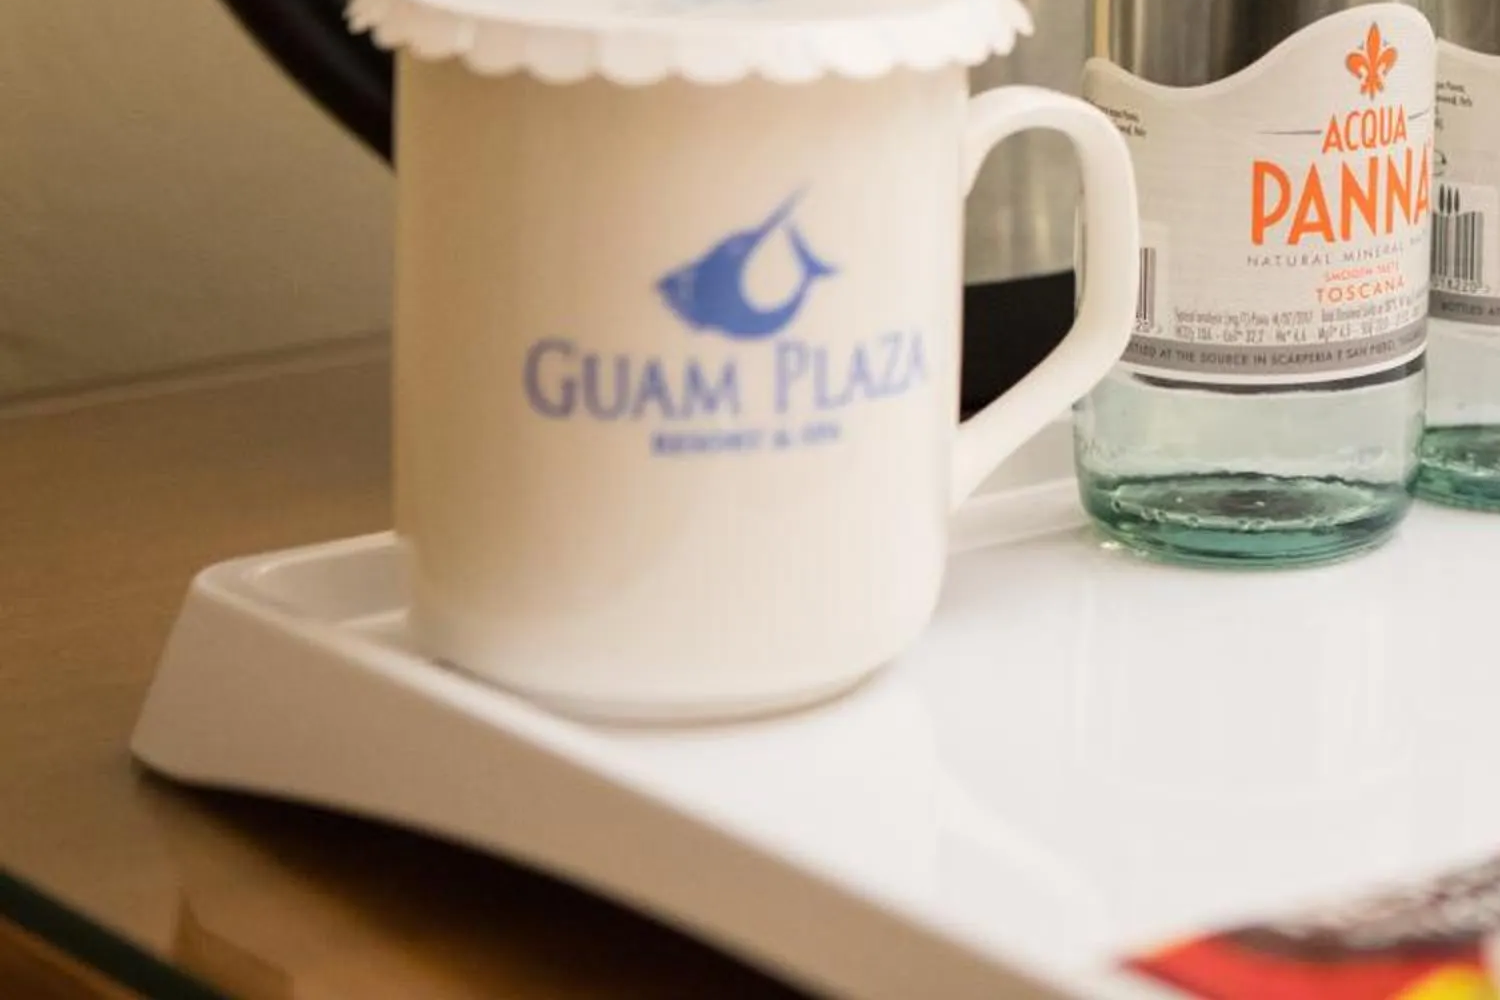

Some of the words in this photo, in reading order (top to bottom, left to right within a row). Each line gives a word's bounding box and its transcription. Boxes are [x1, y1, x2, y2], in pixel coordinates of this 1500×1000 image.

[1322, 104, 1407, 154] ACQUA
[1252, 143, 1430, 245] PANNA
[1247, 252, 1331, 267] NATURAL
[1343, 241, 1403, 261] MINERAL
[1315, 275, 1405, 303] TOSCANA
[523, 336, 740, 421] GUAM
[773, 330, 929, 415] PLAZA
[1175, 349, 1195, 362] THE
[1199, 353, 1248, 365] SOURCE
[1253, 353, 1267, 365] IN
